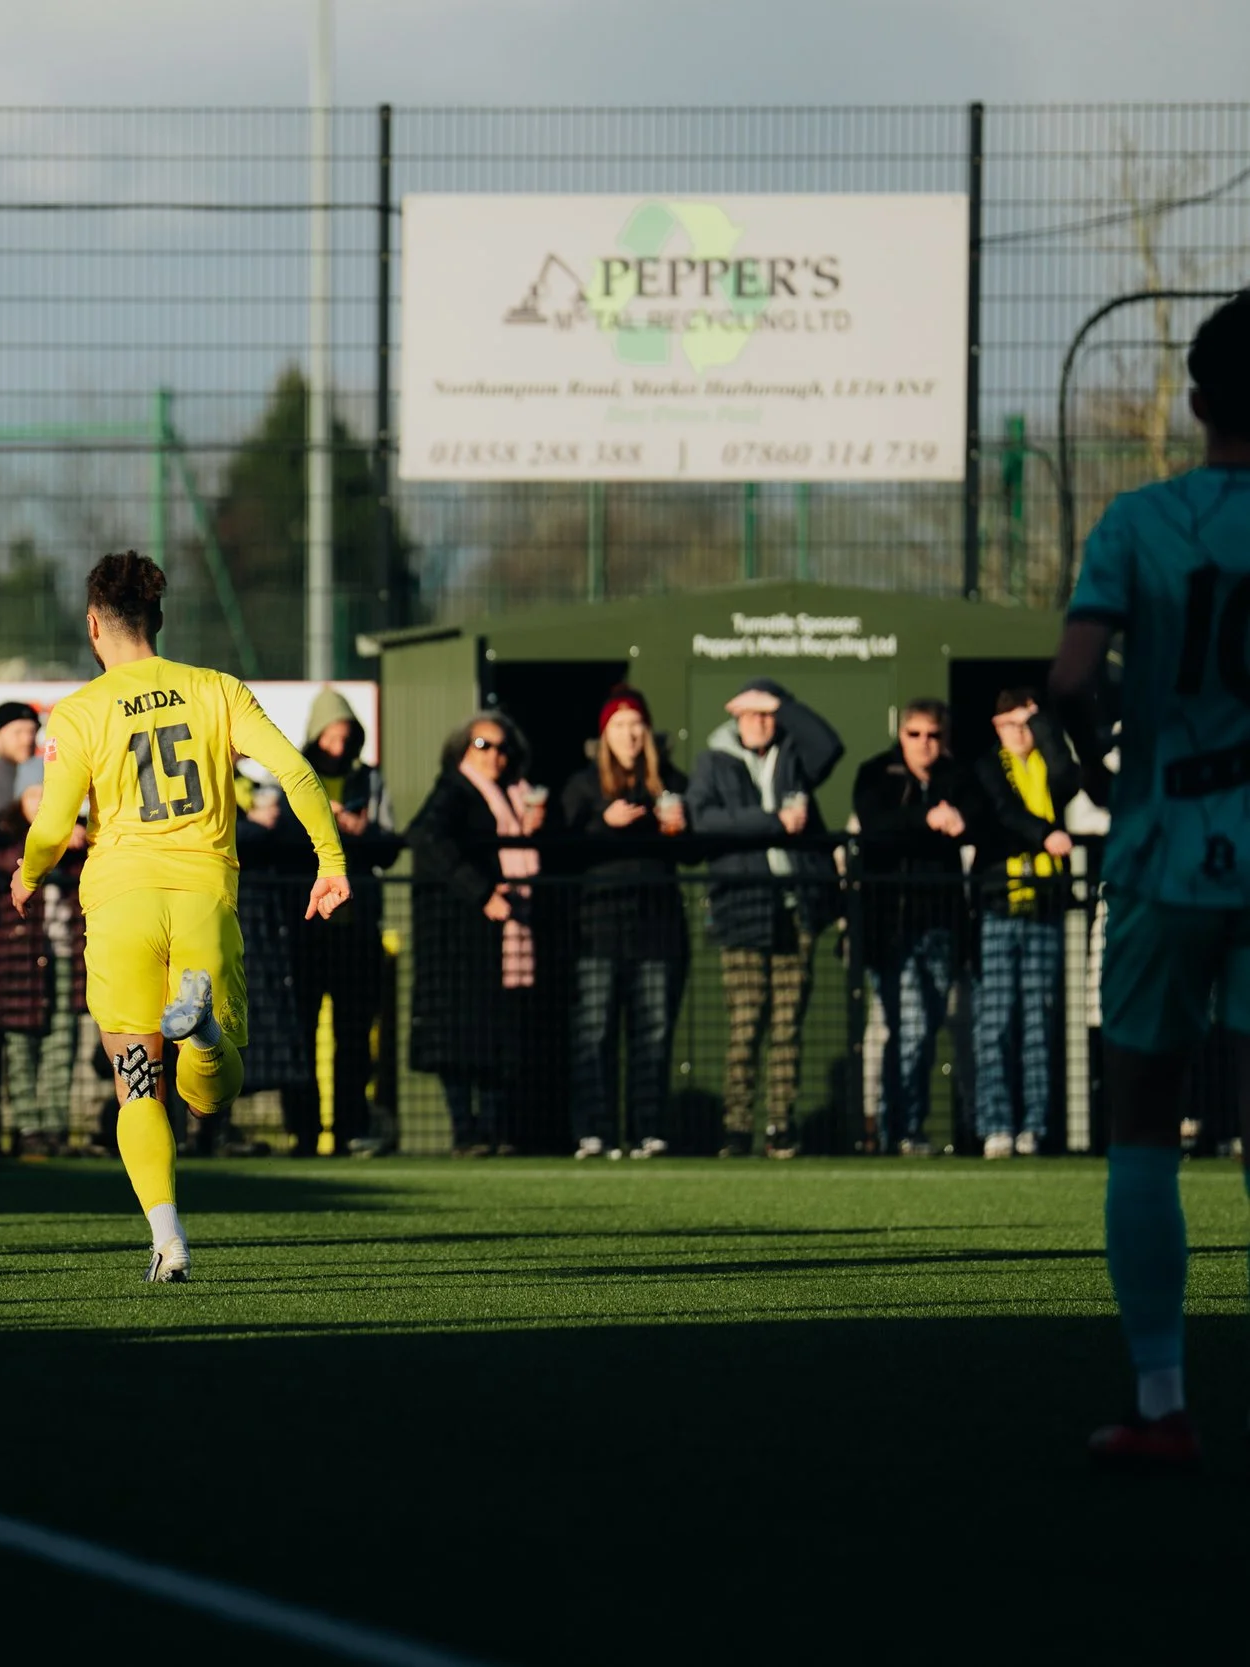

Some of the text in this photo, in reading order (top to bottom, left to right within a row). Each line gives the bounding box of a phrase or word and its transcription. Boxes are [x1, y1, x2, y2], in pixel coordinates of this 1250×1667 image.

[601, 255, 841, 298] PEPPER'S
[646, 308, 797, 332] RECYCLING
[804, 308, 852, 332] LTD
[128, 723, 205, 822] 15
